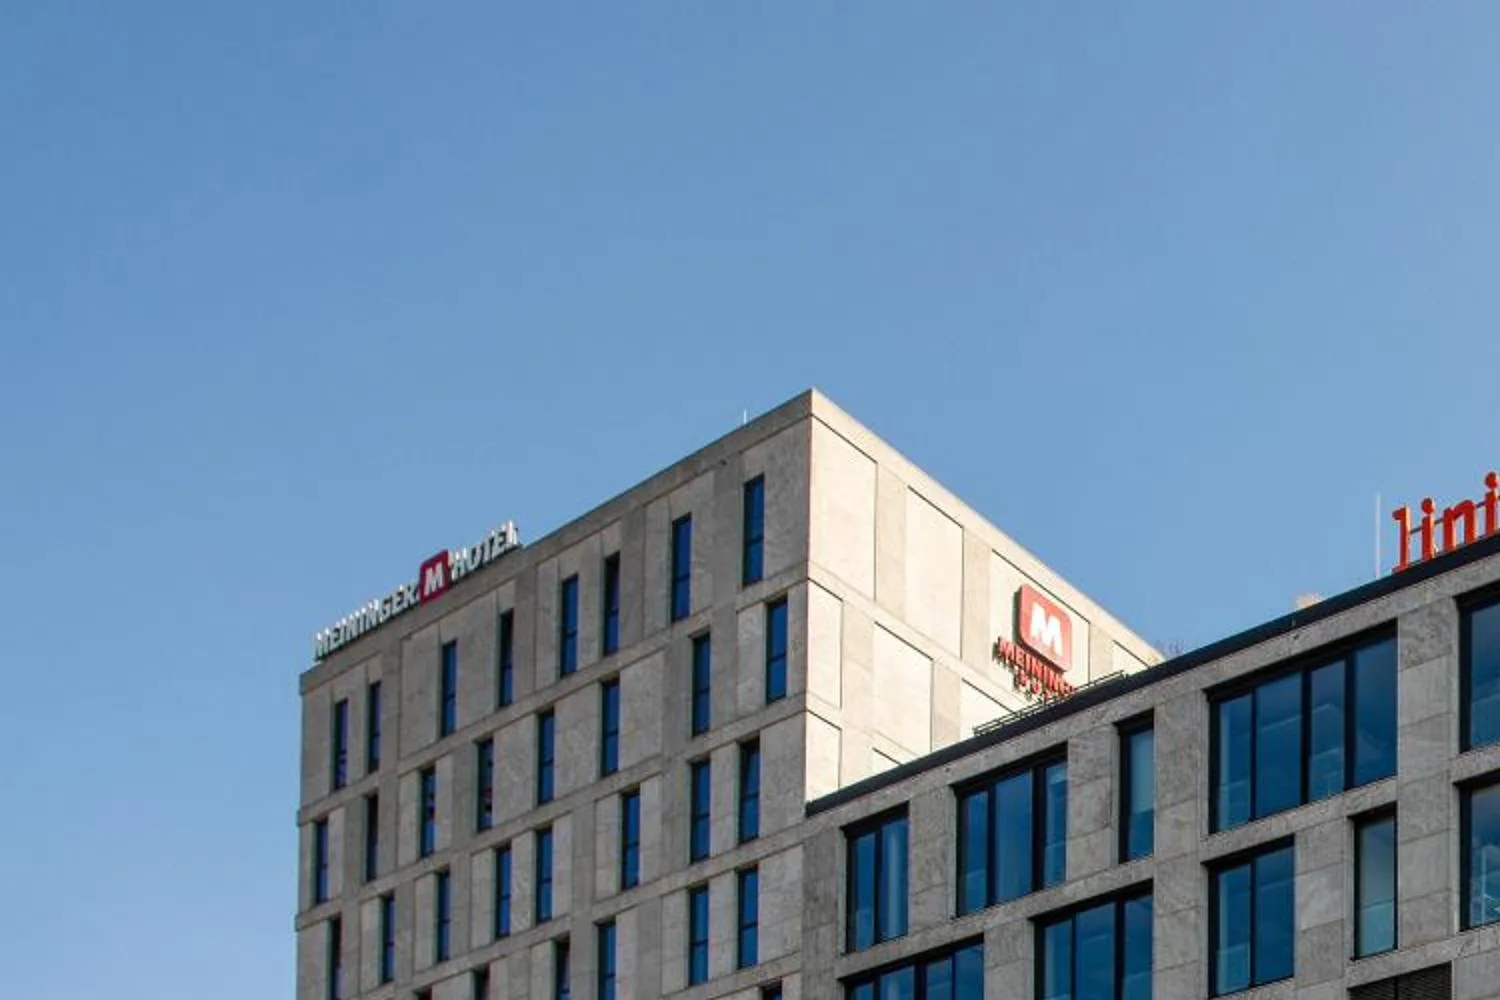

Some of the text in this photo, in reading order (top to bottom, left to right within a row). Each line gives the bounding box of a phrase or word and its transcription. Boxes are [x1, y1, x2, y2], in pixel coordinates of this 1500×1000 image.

[314, 519, 521, 661] MEININGER M HOTEL
[1029, 602, 1063, 658] M
